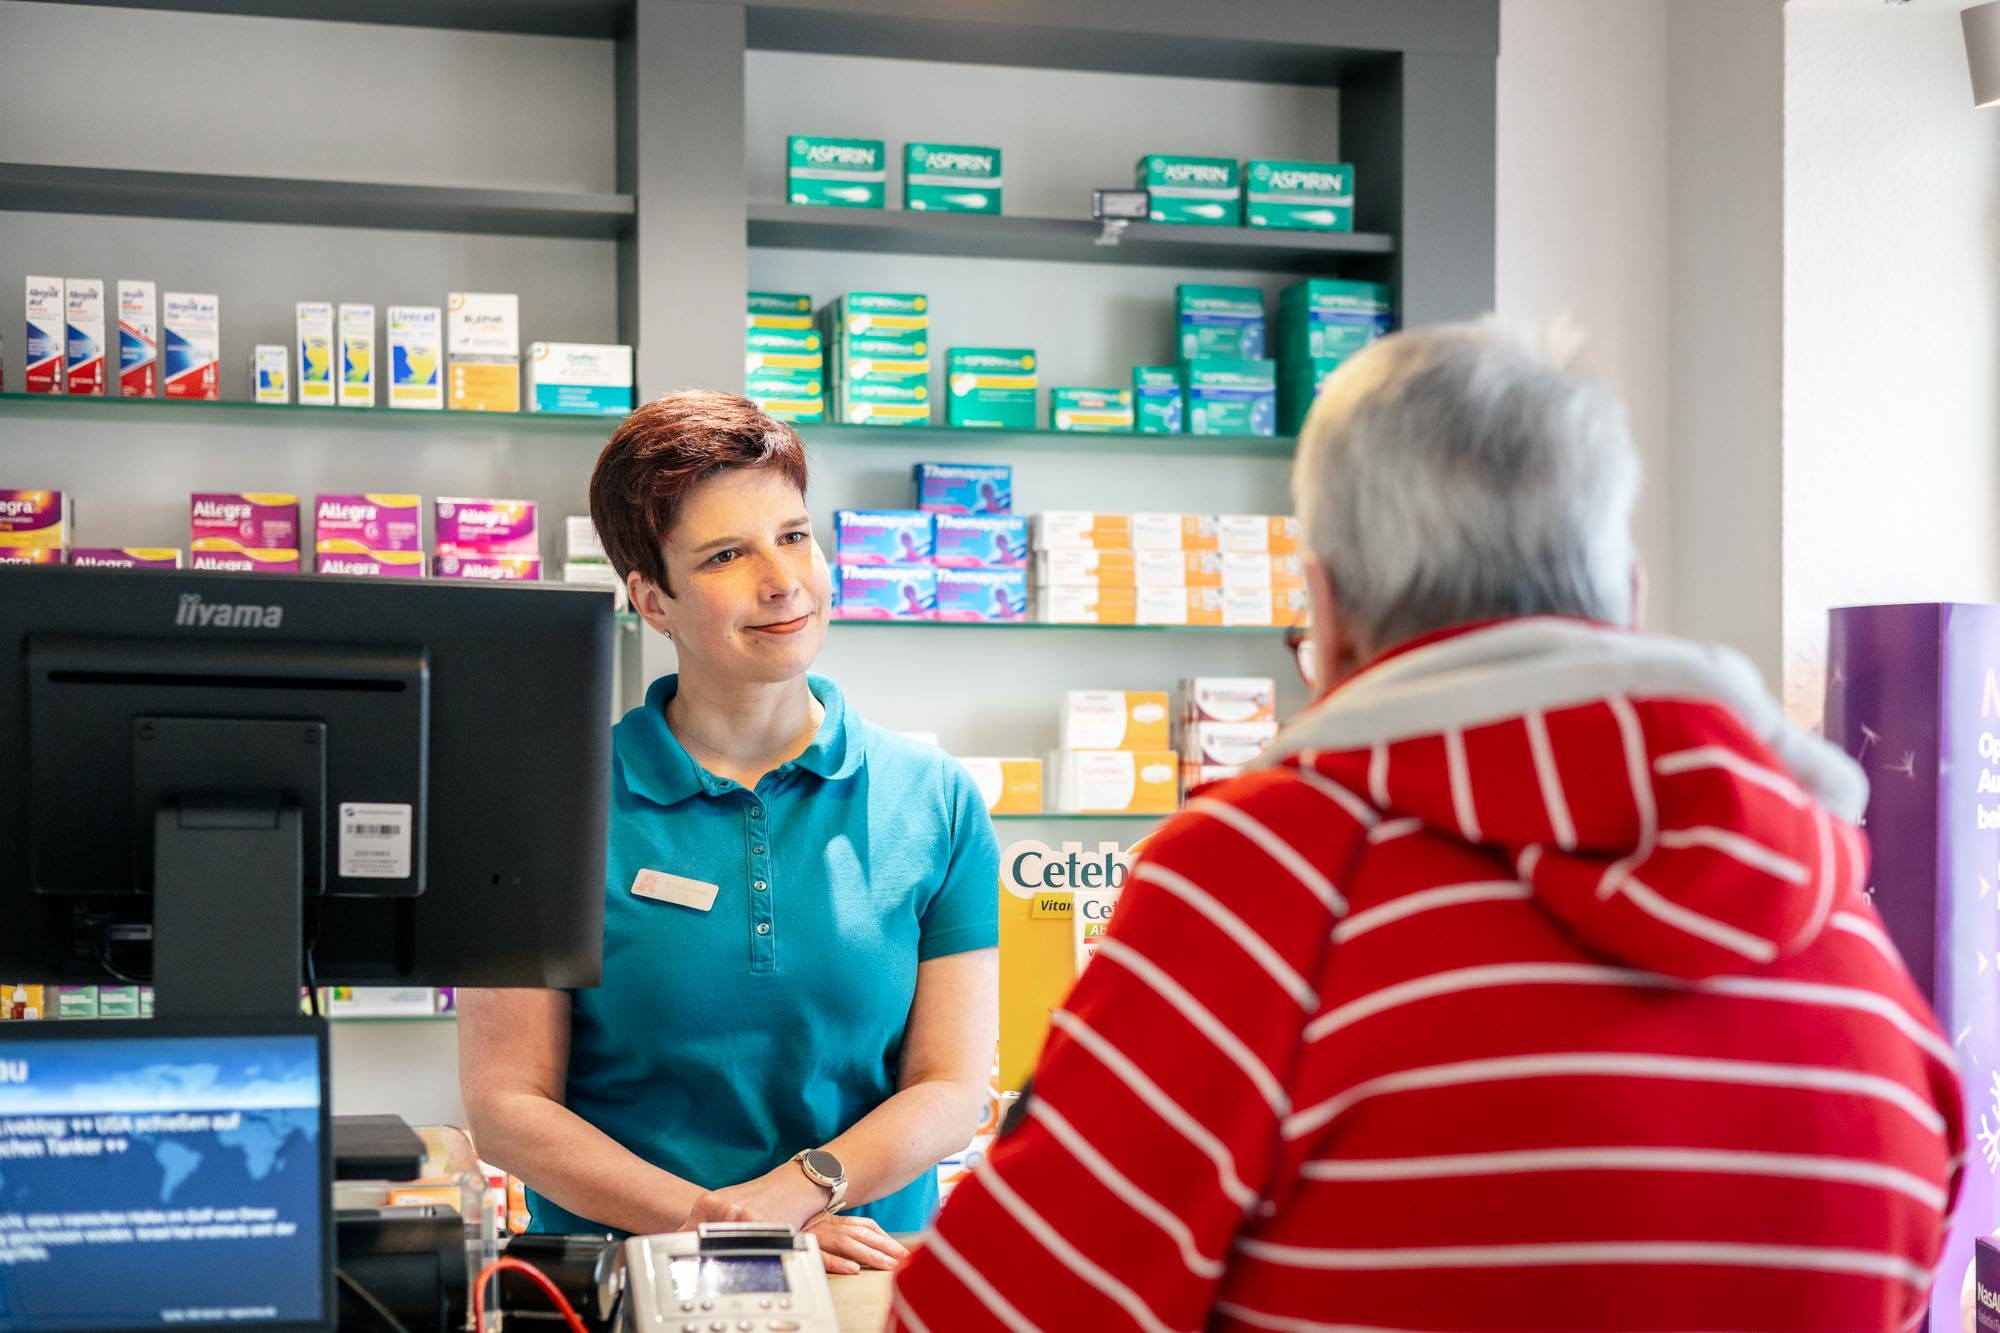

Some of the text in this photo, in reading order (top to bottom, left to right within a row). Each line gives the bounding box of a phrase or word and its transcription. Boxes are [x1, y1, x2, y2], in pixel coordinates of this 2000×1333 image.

[807, 145, 876, 166] ASPIRIN
[925, 152, 993, 172] ASPIRIN
[1164, 164, 1229, 183] ASPIRIN
[1269, 170, 1343, 192] ASPIRIN
[193, 500, 252, 522] Allegra
[318, 501, 377, 523] Allegra
[457, 508, 511, 528] Allegra
[193, 556, 253, 571] Allegra
[321, 559, 380, 577] Allegra
[462, 562, 515, 578] Allegra
[176, 593, 284, 628] iiyama
[1012, 851, 1129, 889] Ceteb
